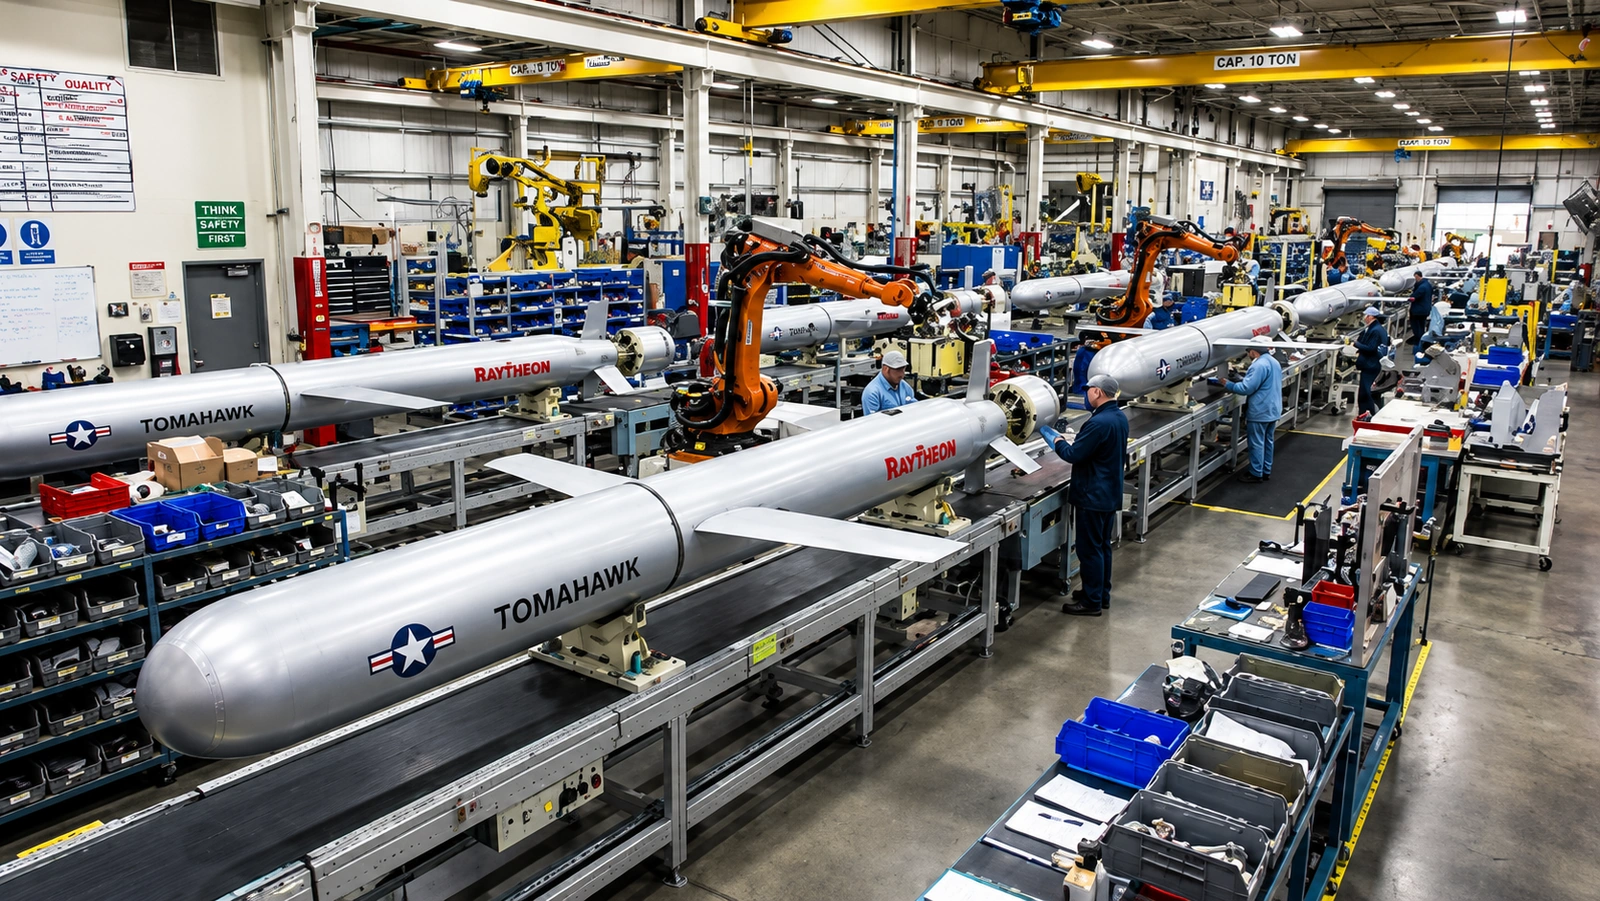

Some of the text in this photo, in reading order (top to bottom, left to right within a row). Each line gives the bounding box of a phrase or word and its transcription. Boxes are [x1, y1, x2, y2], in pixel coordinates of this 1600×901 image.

[1217, 53, 1296, 68] CAP. 10 TON
[64, 79, 112, 91] QUALITY
[946, 118, 964, 127] TON
[201, 205, 237, 215] THINK
[200, 220, 240, 229] SAFETY
[208, 234, 235, 243] FIRST
[474, 360, 550, 383] RAYTHEON
[140, 404, 255, 434] TOMAHAWK
[884, 439, 957, 481] RAYTHEON
[493, 556, 641, 631] TOMAHAWK
